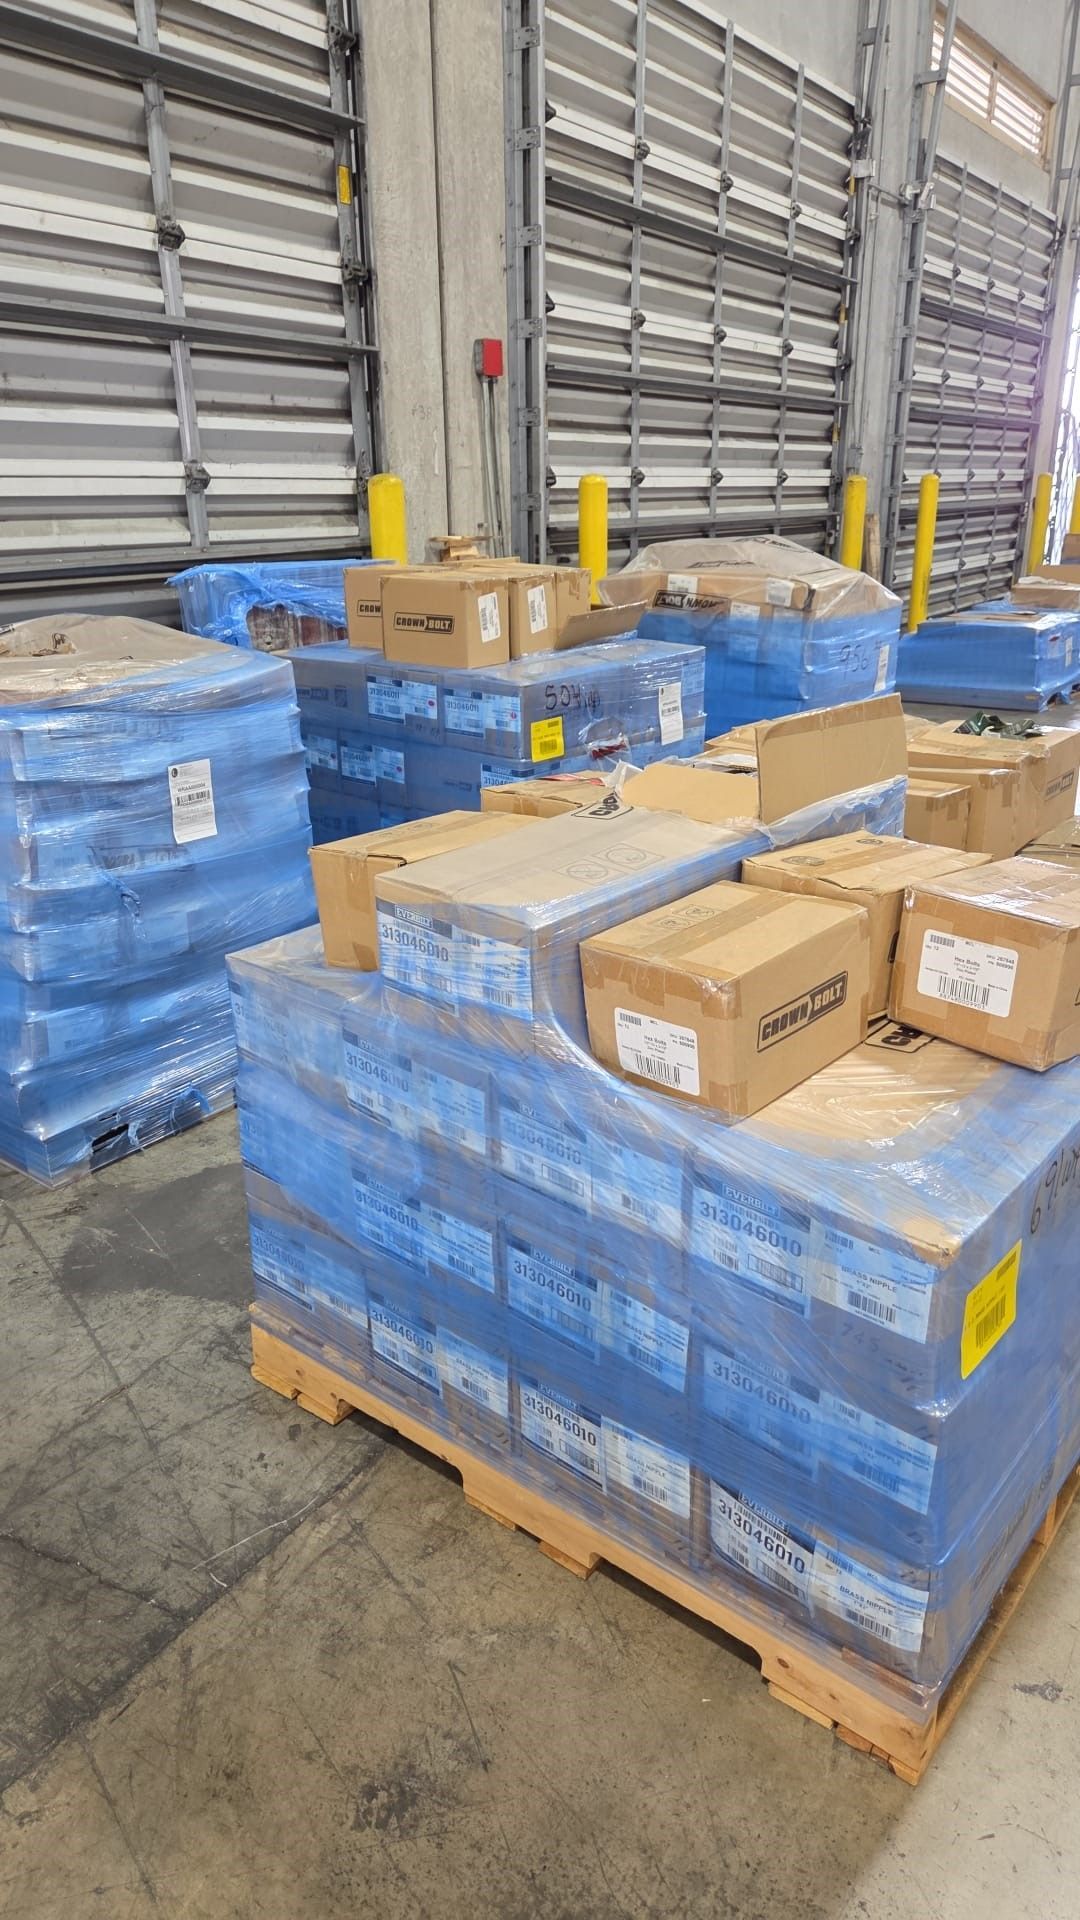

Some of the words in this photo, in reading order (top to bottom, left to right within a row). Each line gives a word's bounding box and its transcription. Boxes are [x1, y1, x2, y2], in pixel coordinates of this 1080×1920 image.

[359, 603, 381, 613] CROW
[396, 616, 425, 627] CROWN
[428, 617, 452, 630] BOLT
[382, 924, 449, 962] 313046010
[762, 1001, 809, 1041] CROWN
[813, 982, 843, 1011] BOLT
[346, 1051, 409, 1093] 313046010
[699, 1200, 802, 1257] 313046010
[513, 1259, 592, 1313] 313046010
[869, 1276, 897, 1294] NIPPLE
[712, 1360, 812, 1425] 313046010
[523, 1392, 597, 1447] 313046010
[718, 1498, 806, 1575] 313046010
[839, 1585, 865, 1602] BRASS
[866, 1599, 893, 1617] NIPPLE
